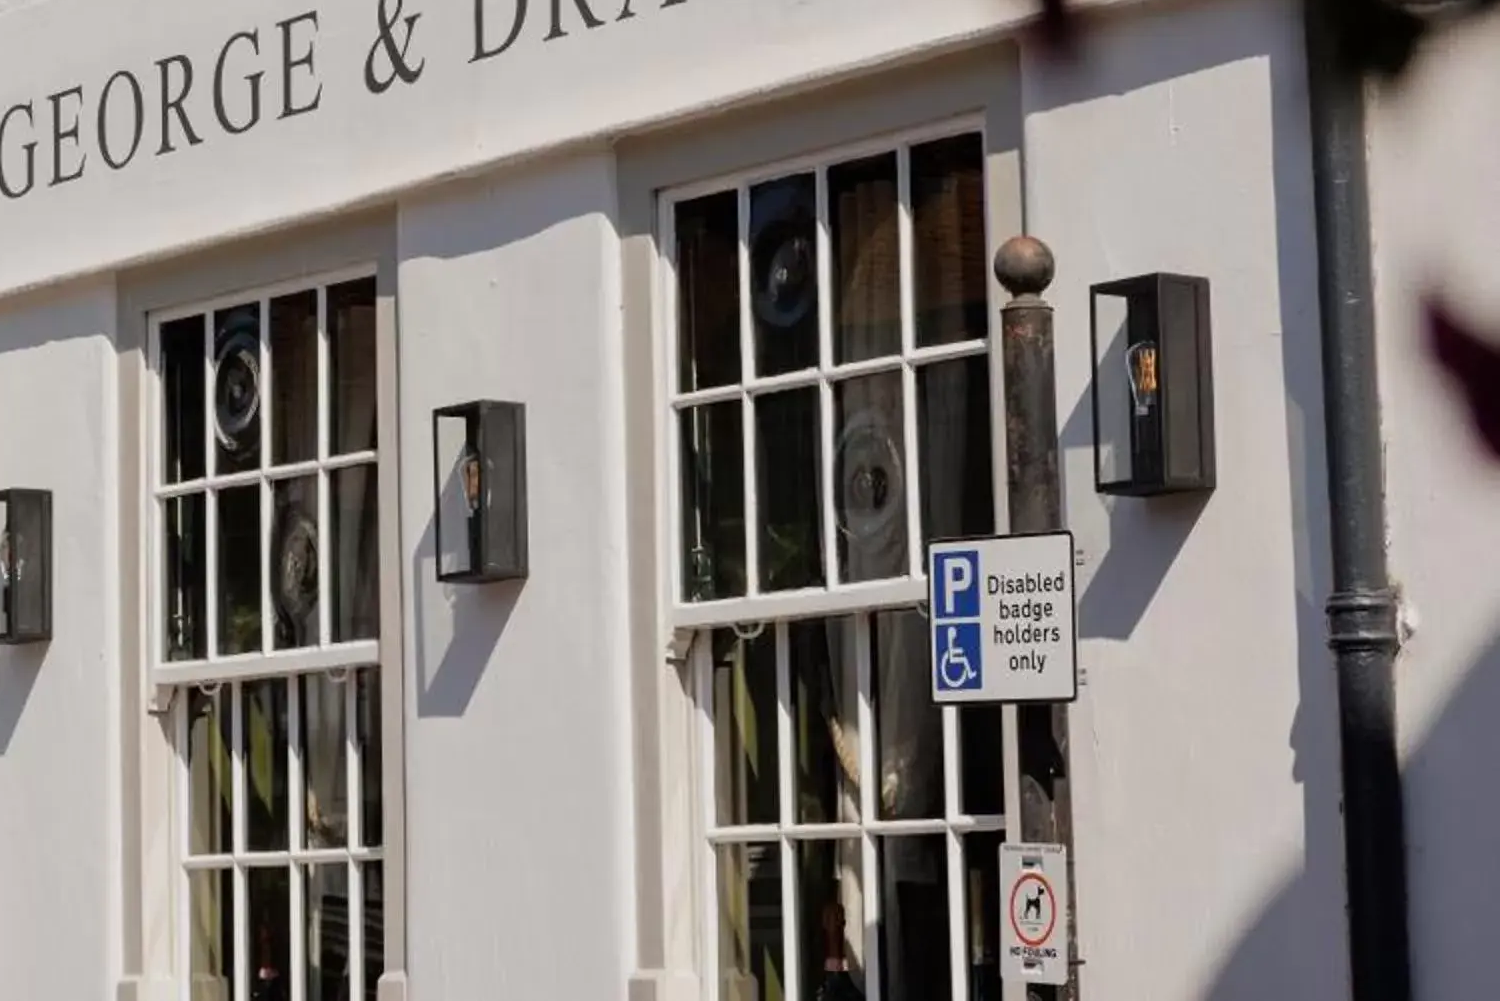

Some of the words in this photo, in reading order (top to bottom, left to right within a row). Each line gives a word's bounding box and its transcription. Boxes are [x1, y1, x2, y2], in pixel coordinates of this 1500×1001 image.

[943, 557, 972, 614] P
[987, 571, 1065, 595] Disabled
[999, 599, 1053, 621] badge
[994, 624, 1060, 644] holders
[1009, 650, 1046, 674] only
